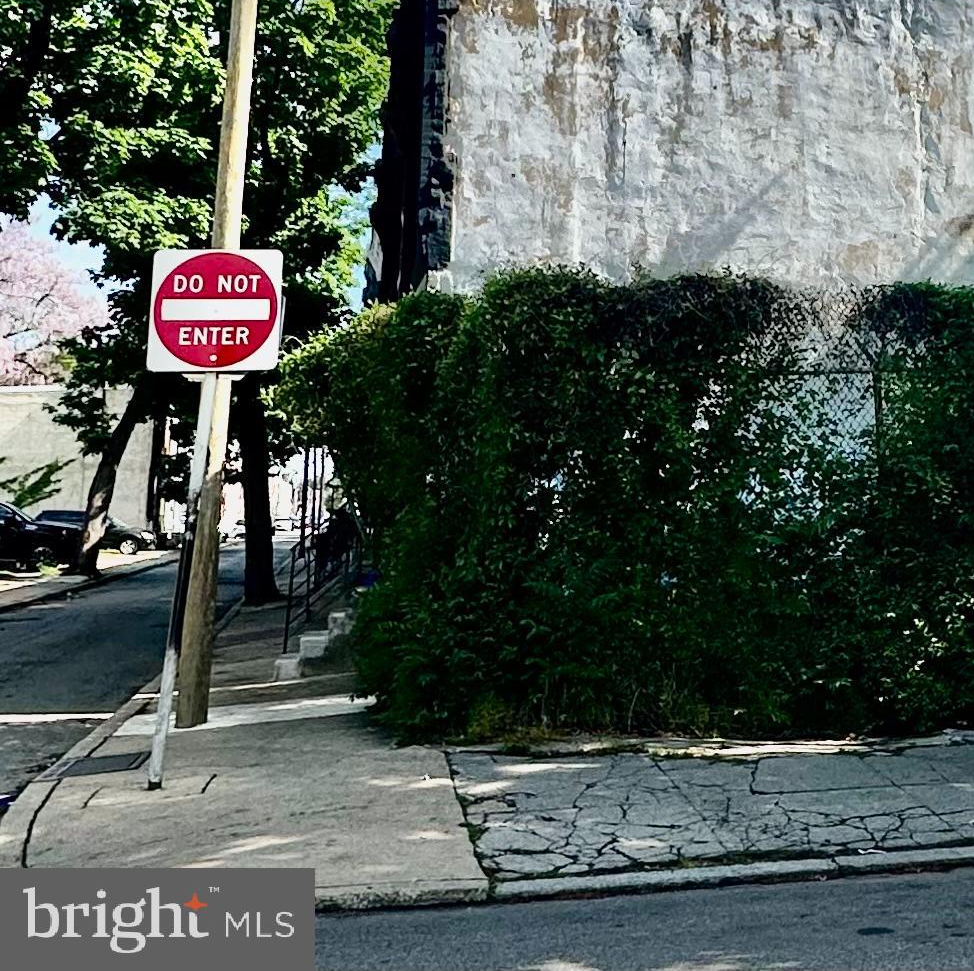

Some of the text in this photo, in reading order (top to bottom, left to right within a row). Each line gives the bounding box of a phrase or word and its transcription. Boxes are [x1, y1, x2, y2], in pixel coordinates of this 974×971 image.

[173, 274, 262, 293] DO NOT
[178, 327, 250, 346] ENTER
